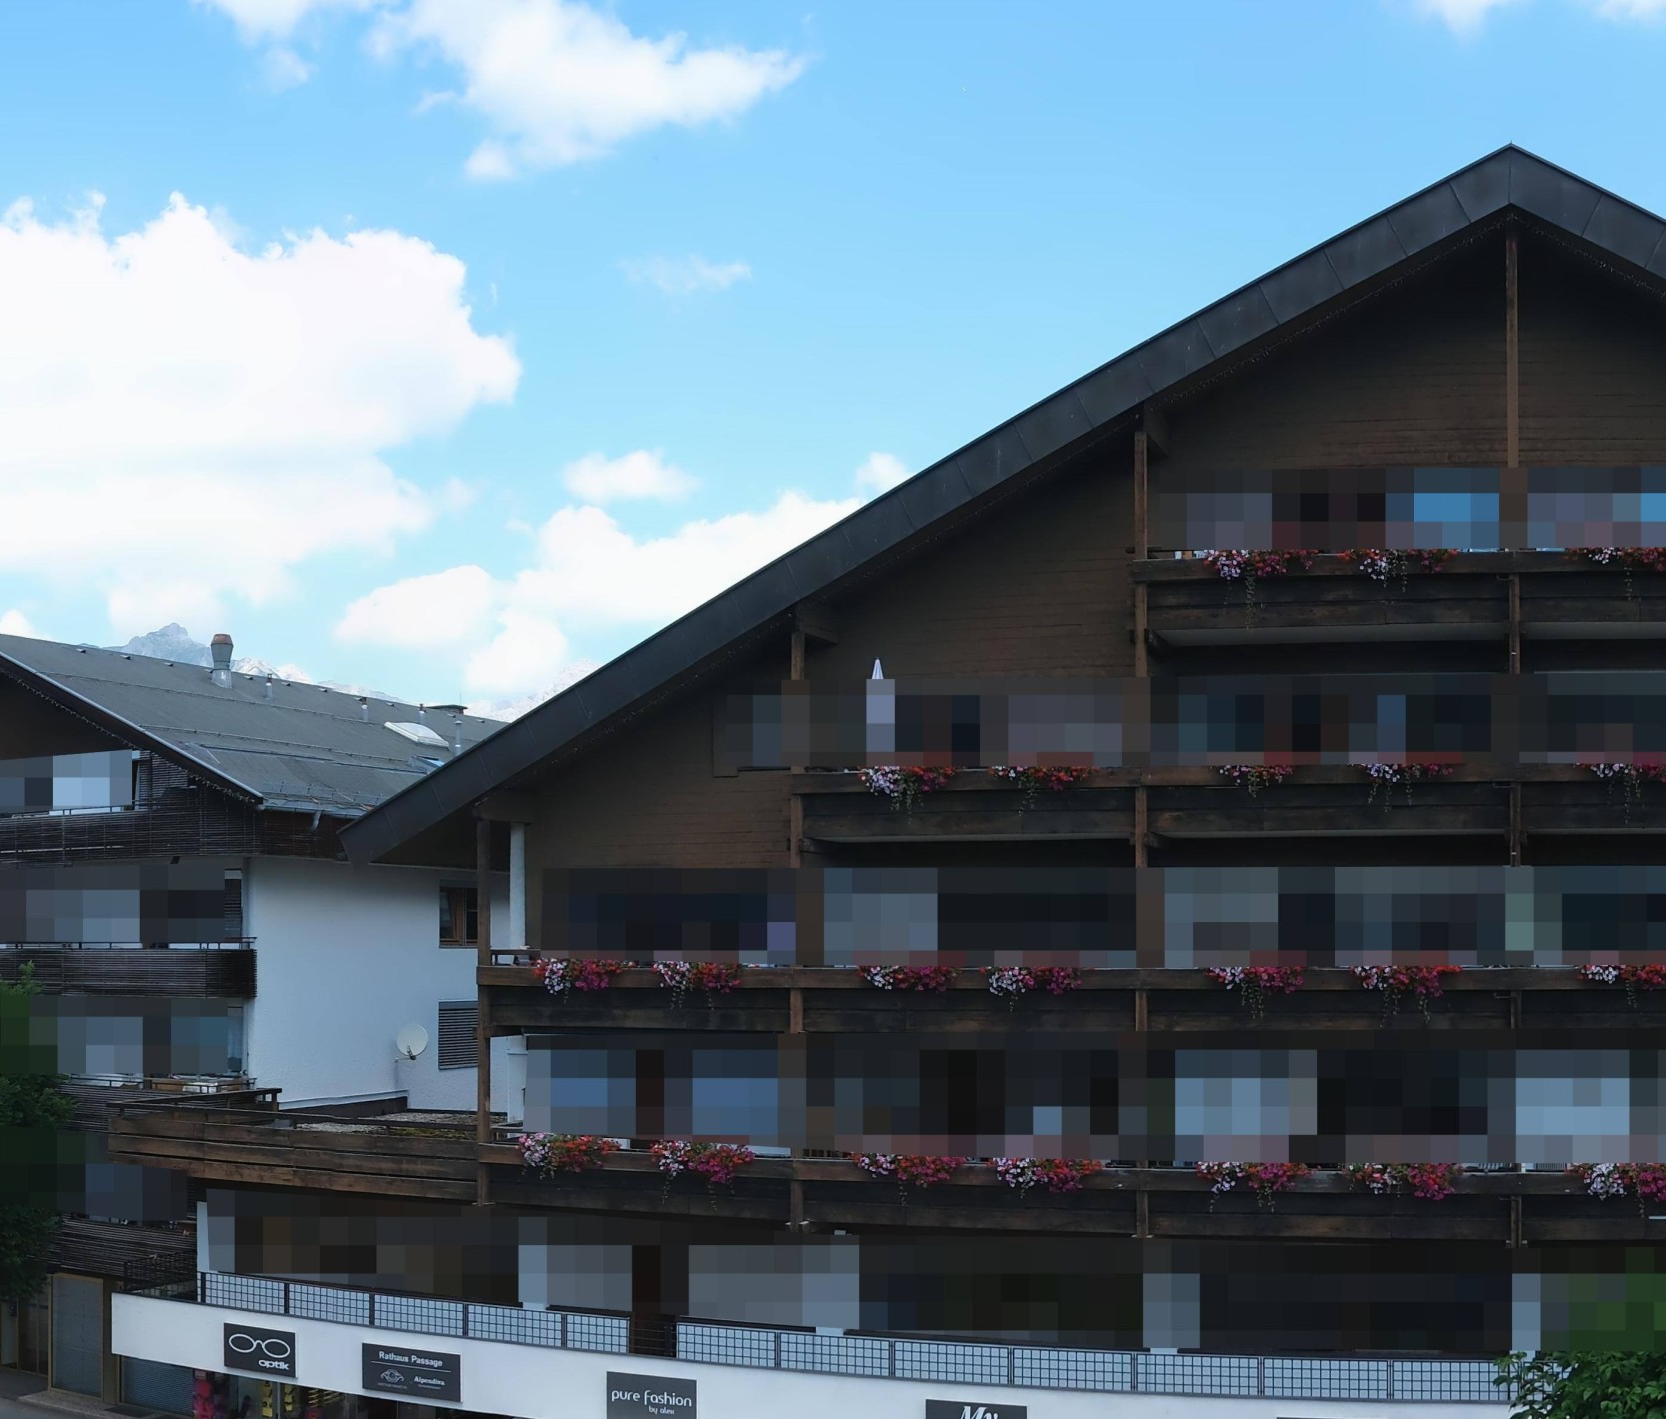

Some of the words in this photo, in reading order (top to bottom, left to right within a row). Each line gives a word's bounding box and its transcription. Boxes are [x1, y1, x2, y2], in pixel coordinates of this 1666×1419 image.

[258, 1358, 290, 1372] optik
[378, 1350, 409, 1363] Rathaus
[411, 1355, 443, 1368] Passage
[611, 1388, 641, 1404] pure
[644, 1389, 693, 1408] fashion
[648, 1406, 658, 1416] by
